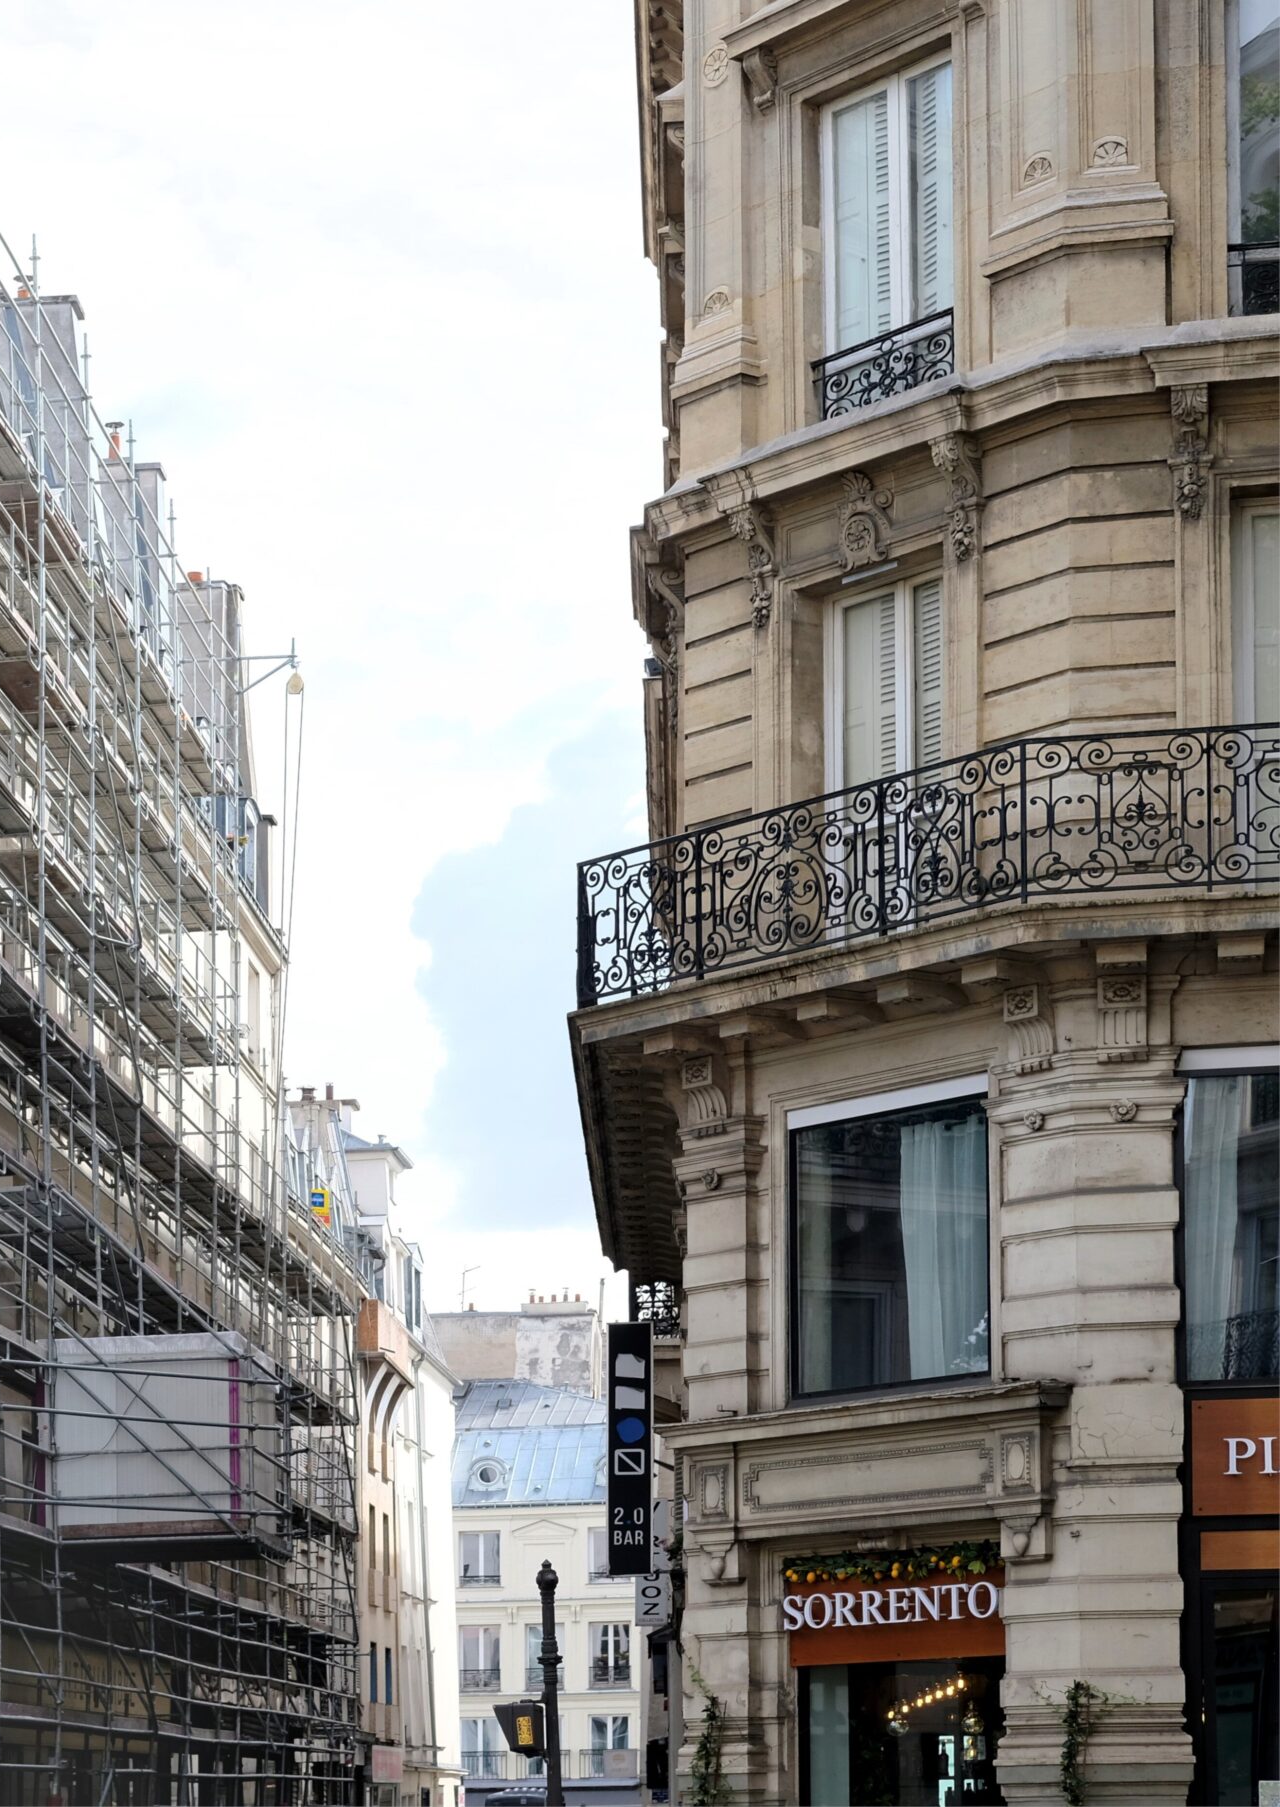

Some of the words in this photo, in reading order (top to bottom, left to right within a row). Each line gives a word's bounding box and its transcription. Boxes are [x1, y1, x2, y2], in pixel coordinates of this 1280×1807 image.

[1222, 1436, 1280, 1476] PI
[613, 1507, 644, 1525] 2.0
[613, 1530, 644, 1546] BAR
[782, 1581, 999, 1631] SORRENTO
